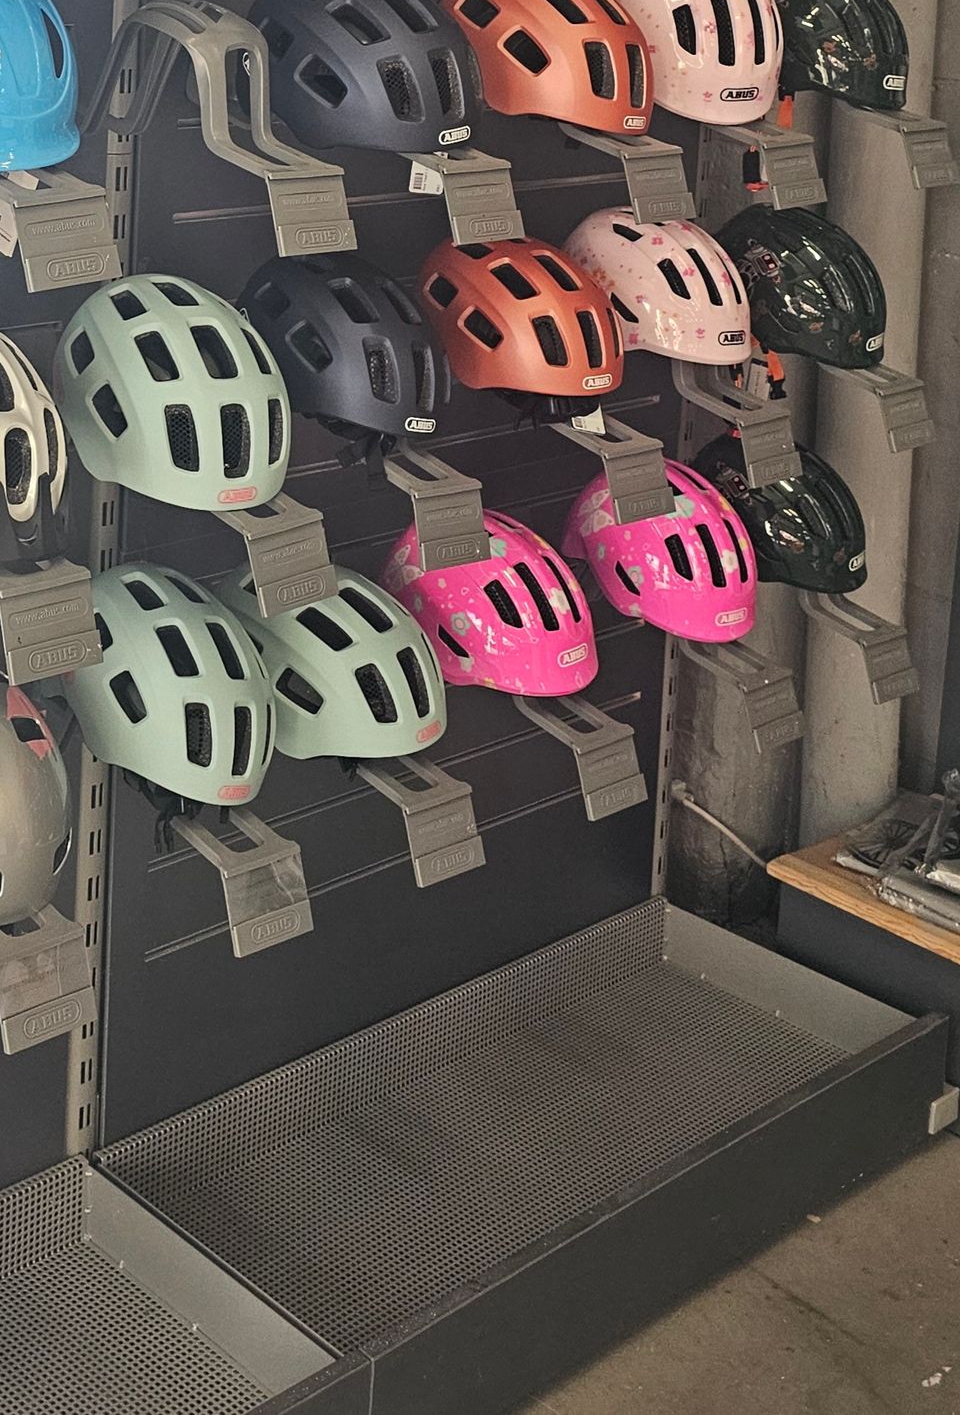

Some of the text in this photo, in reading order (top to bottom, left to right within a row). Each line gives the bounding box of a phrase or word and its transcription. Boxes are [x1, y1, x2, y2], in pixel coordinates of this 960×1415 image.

[725, 89, 756, 99] ABUS
[444, 128, 468, 143] ABUS
[32, 218, 95, 235] www.abus.com
[473, 219, 506, 233] ABUS
[301, 229, 337, 243] ABUS
[55, 259, 97, 276] ABUS
[722, 333, 744, 343] ABUS
[587, 376, 609, 387] ABUS
[409, 420, 433, 430] ABUS
[222, 488, 253, 501] ABUS
[281, 579, 319, 599] ABUS
[15, 602, 80, 626] www.abus.com
[721, 610, 746, 624] ABUS
[35, 645, 78, 667] ABUS
[562, 647, 586, 664] ABUS
[256, 912, 293, 938] ABUS
[31, 1006, 72, 1034] ABUS
